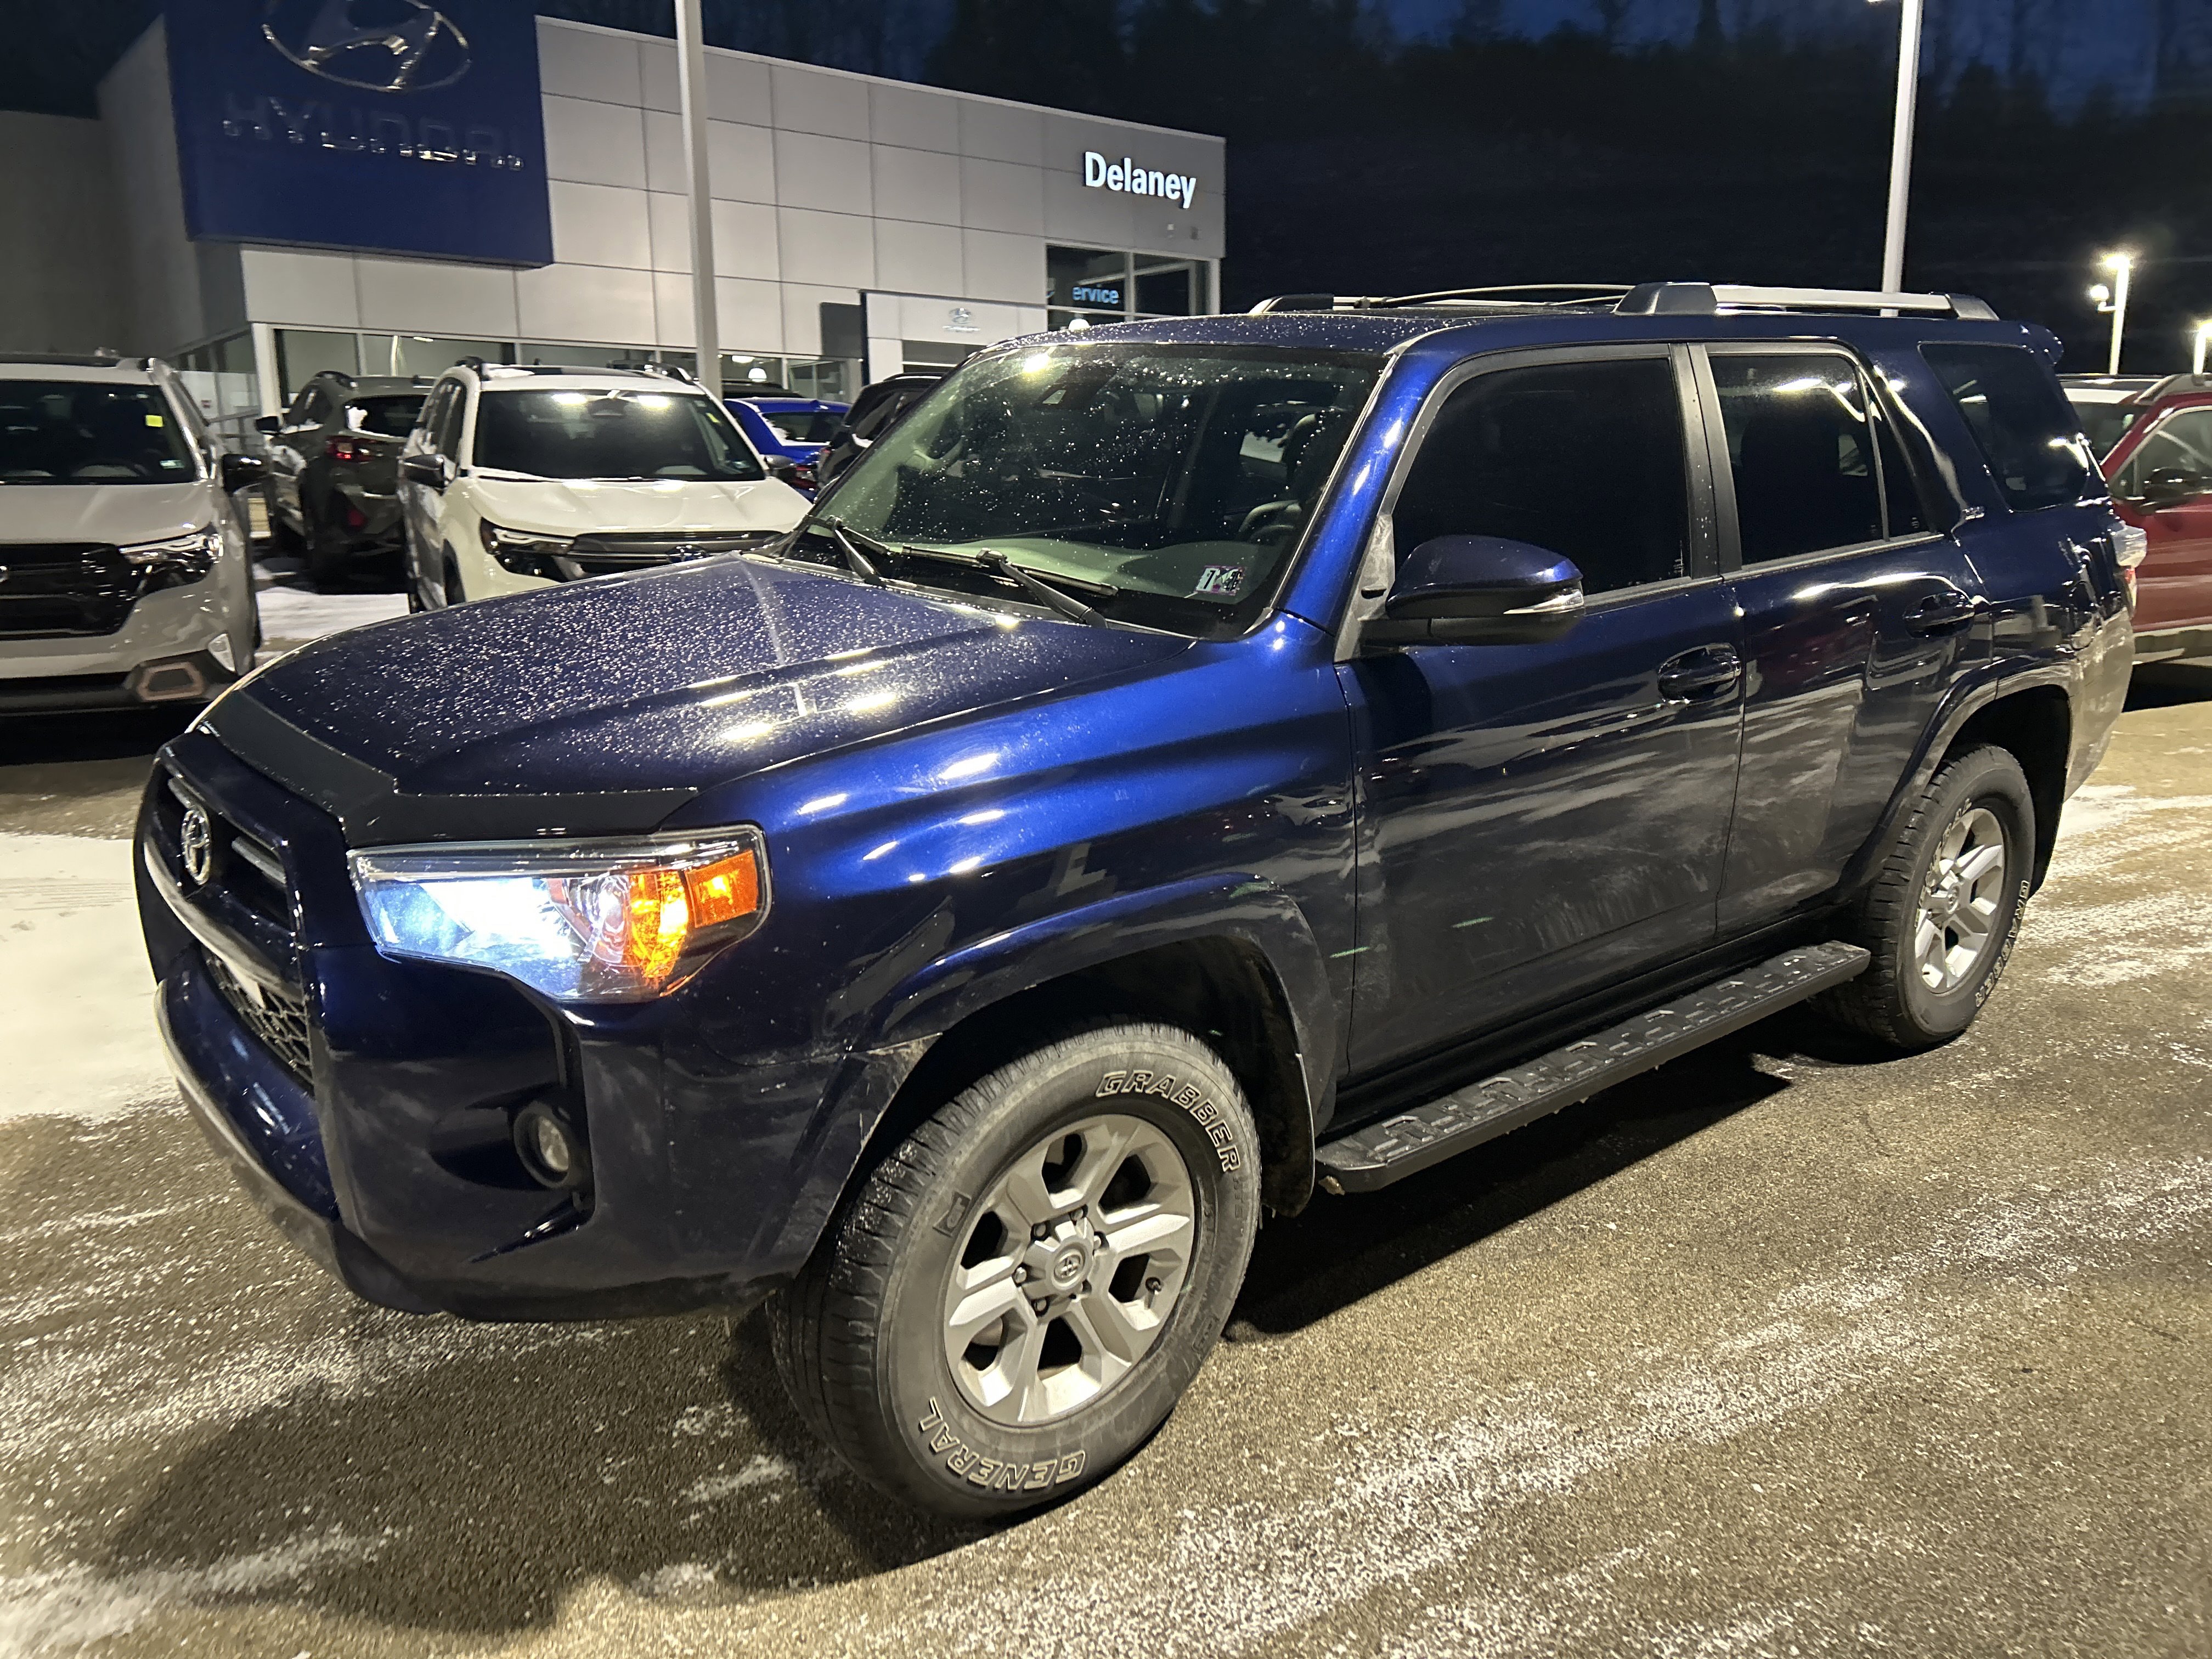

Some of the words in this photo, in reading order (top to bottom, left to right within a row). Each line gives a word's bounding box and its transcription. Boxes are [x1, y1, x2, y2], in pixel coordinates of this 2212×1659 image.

[1085, 151, 1197, 209] Delaney
[1096, 1069, 1241, 1172] GRABBER
[919, 1396, 1086, 1490] GENERAL
